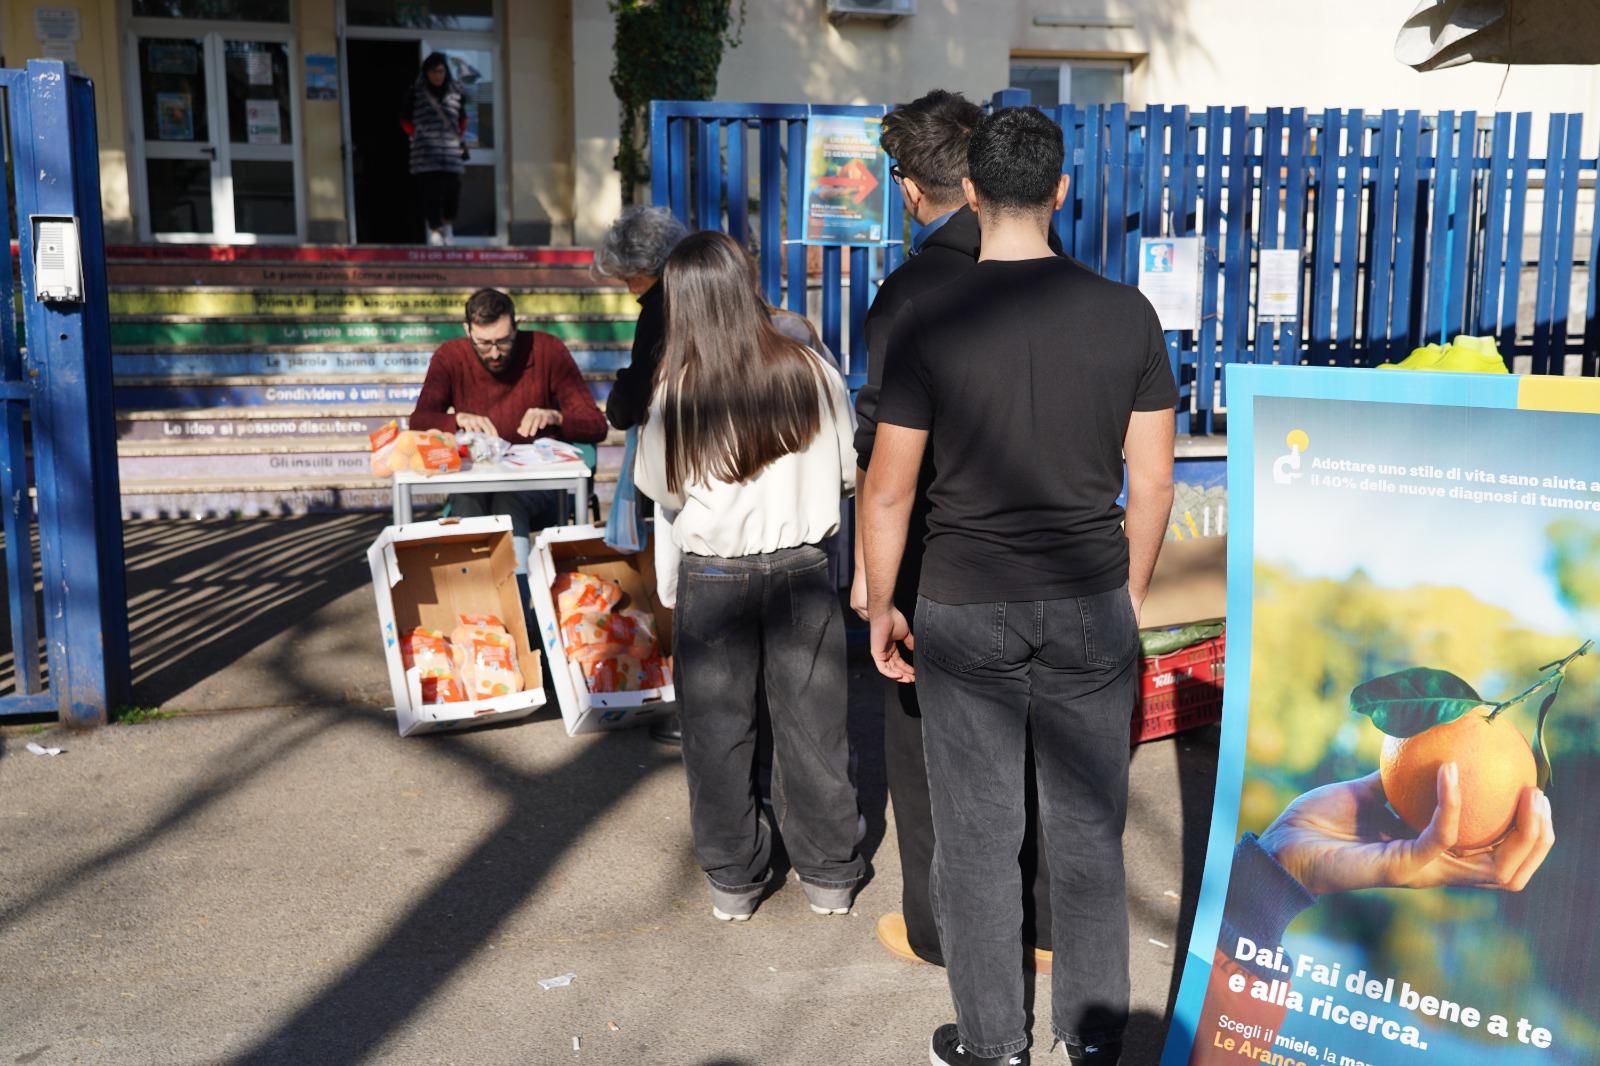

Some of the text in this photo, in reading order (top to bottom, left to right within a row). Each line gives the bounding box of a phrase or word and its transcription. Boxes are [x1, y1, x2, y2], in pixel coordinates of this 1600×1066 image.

[258, 297, 292, 307] Prima
[296, 297, 308, 307] di
[315, 297, 354, 310] parlare
[363, 297, 409, 310] bisogna
[303, 326, 342, 339] parole
[347, 327, 378, 337] sono
[381, 327, 396, 337] un
[266, 356, 281, 367] Le
[289, 356, 327, 369] parole
[336, 356, 376, 367] hanno
[266, 387, 346, 401] Condividere
[349, 387, 359, 401] è
[164, 422, 182, 435] Le
[185, 421, 214, 435] idee
[220, 421, 233, 435] si
[237, 422, 297, 437] possono
[269, 454, 363, 468] Gli insulti non
[1311, 456, 1376, 474] Adottare
[1378, 463, 1407, 477] uno
[1409, 463, 1443, 480] stile
[1446, 466, 1462, 481] di
[1463, 467, 1496, 484] vita
[1499, 473, 1539, 487] sano
[1542, 475, 1587, 491] aiuta
[1322, 475, 1357, 489] 40%
[1359, 478, 1397, 494] delle
[1399, 484, 1446, 498] nuove
[1448, 486, 1518, 507] diagnosi
[1520, 492, 1537, 506] di
[1234, 936, 1553, 1048] Dai. Fai del bene a te
[1228, 974, 1429, 1050] e alla ricerca.
[1213, 1031, 1236, 1051] Le
[1218, 1014, 1262, 1039] Scegli
[1264, 1029, 1274, 1043] il
[1274, 1034, 1320, 1061] miele,
[1323, 1047, 1337, 1064] la
